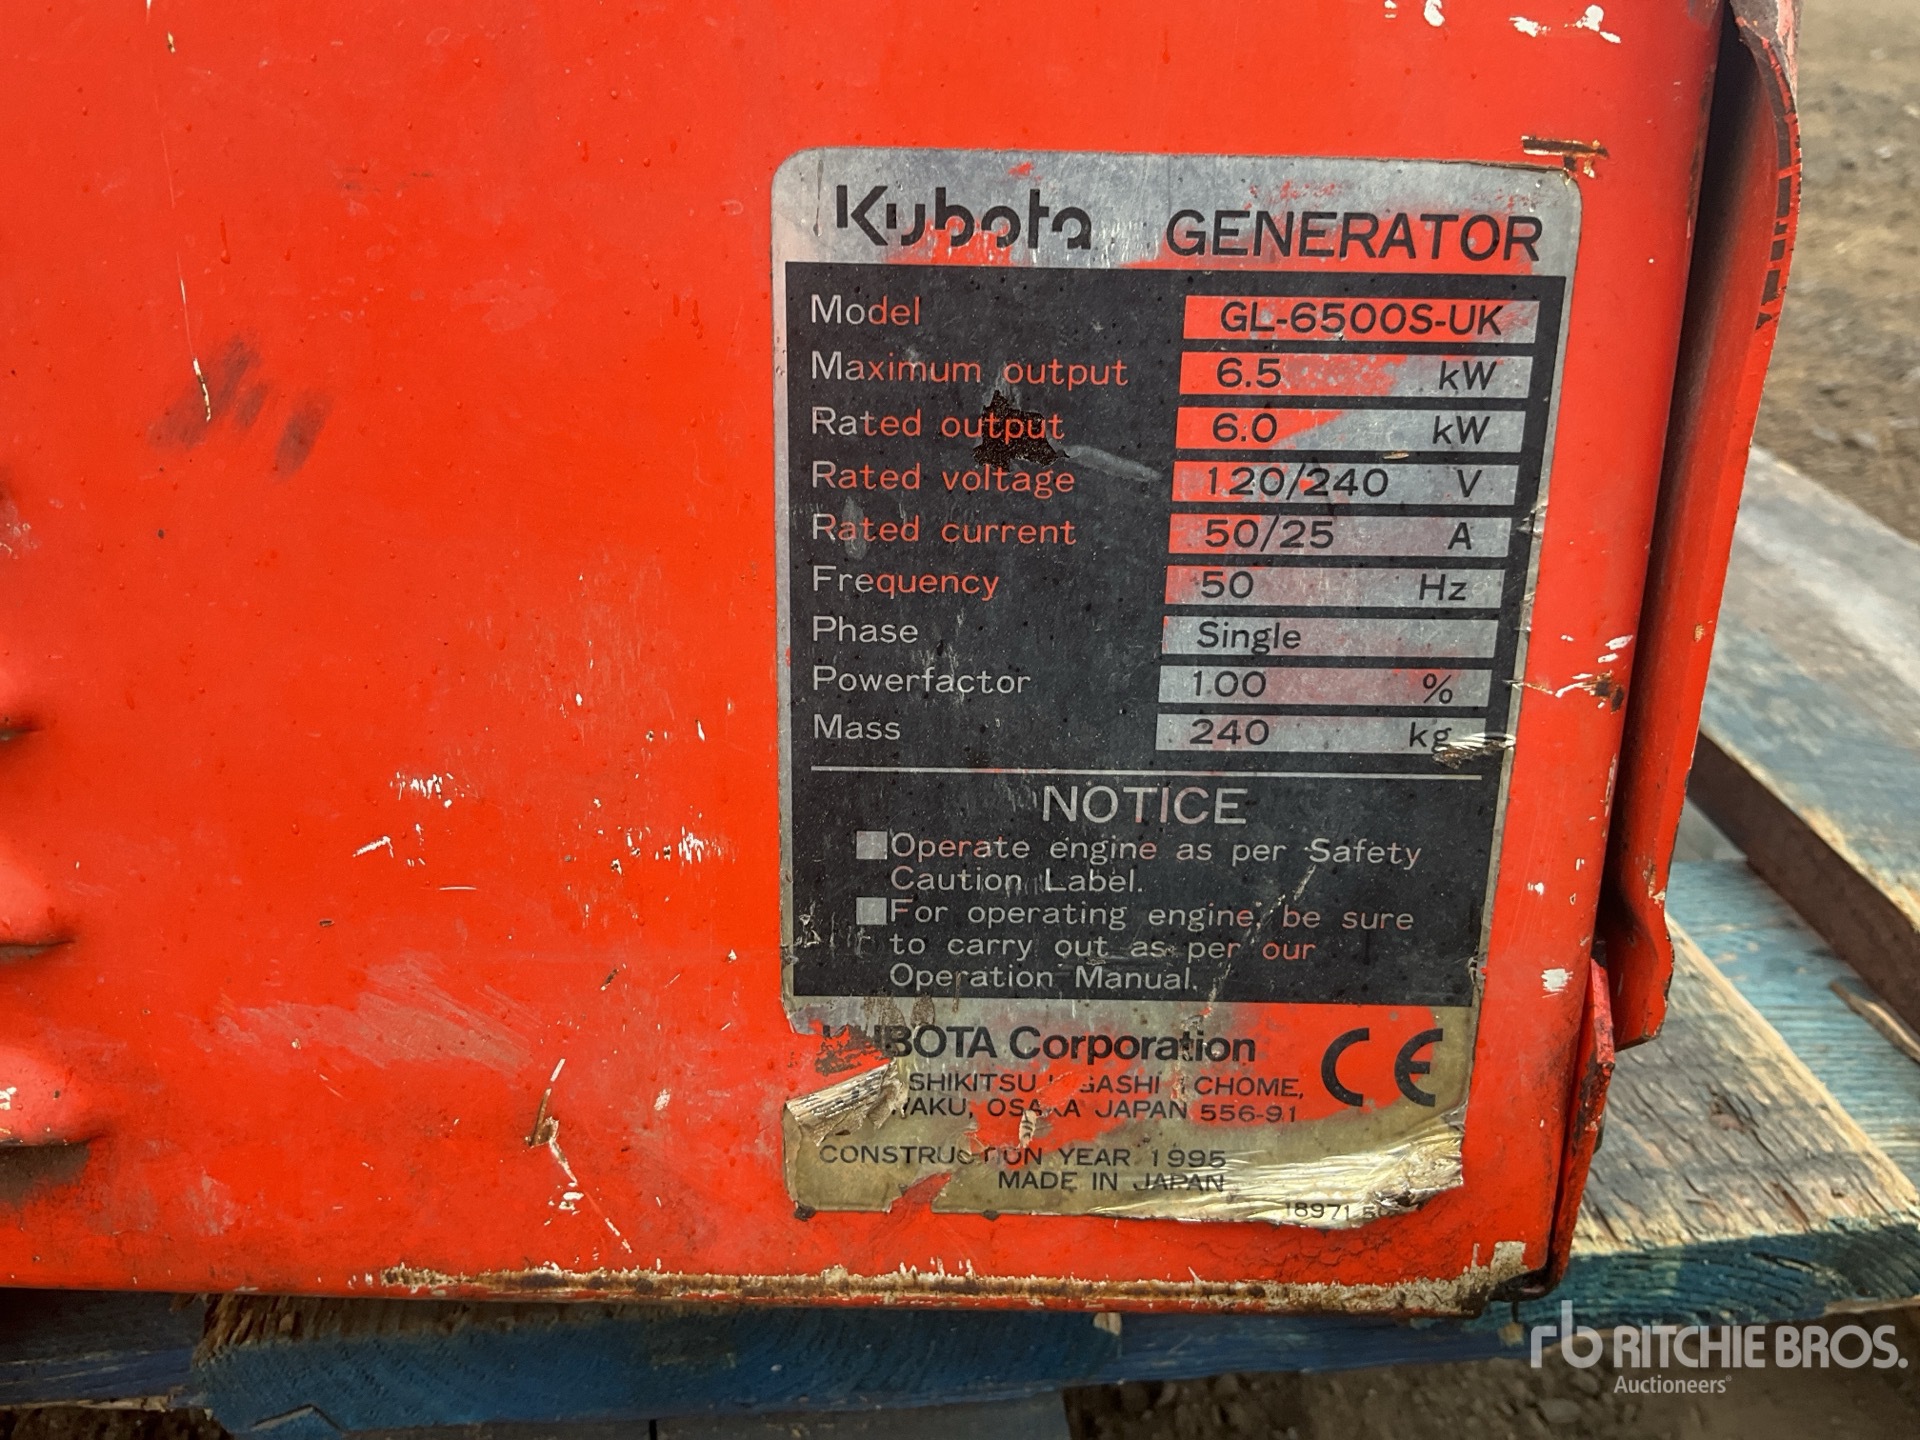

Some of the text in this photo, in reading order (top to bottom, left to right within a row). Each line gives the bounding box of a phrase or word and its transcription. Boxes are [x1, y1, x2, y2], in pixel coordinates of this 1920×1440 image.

[835, 184, 1092, 249] Kubota
[1167, 209, 1542, 262] GENERATOR
[811, 294, 920, 325] Model
[1220, 301, 1503, 336] GL-6500S-UK
[812, 351, 1128, 391] Maximum output
[1216, 358, 1497, 390] 6.5 kW
[812, 406, 1064, 444] Rated output
[1212, 413, 1490, 445] 6.0 kW
[812, 460, 1075, 498] Rated voltage
[1209, 463, 1482, 500] 120/240 V
[812, 513, 1076, 544] Rated current
[1205, 515, 1472, 551] 50/25 A
[813, 566, 999, 601] Frequency
[1201, 571, 1467, 600] 50 Hz
[812, 616, 918, 643] Phase
[1197, 621, 1301, 654] Single
[813, 666, 1031, 694] Powerfactor
[1193, 671, 1453, 704] 100 %
[814, 714, 901, 740] Mass
[1190, 719, 1452, 751] 240 kg
[1043, 786, 1248, 824] NOTICE
[891, 832, 1421, 870] Operate engine as per Safety
[891, 866, 1143, 892] Caution Label.
[890, 899, 948, 923] For
[967, 901, 1127, 930] operating
[1283, 905, 1321, 929] be
[1342, 911, 1413, 930] sure
[890, 933, 1316, 963] to carry out as per our
[890, 963, 1198, 991] Operation Manual.
[1009, 1026, 1255, 1065] Corporation
[908, 1073, 1036, 1093] SHIKITSU
[1321, 1027, 1443, 1107] CE
[1096, 1099, 1187, 1119] JAPAN
[1201, 1104, 1296, 1123] 556-91
[1060, 1147, 1131, 1166] YEAR
[1152, 1149, 1226, 1168] 1995
[998, 1171, 1224, 1192] MADE IN JAPAN
